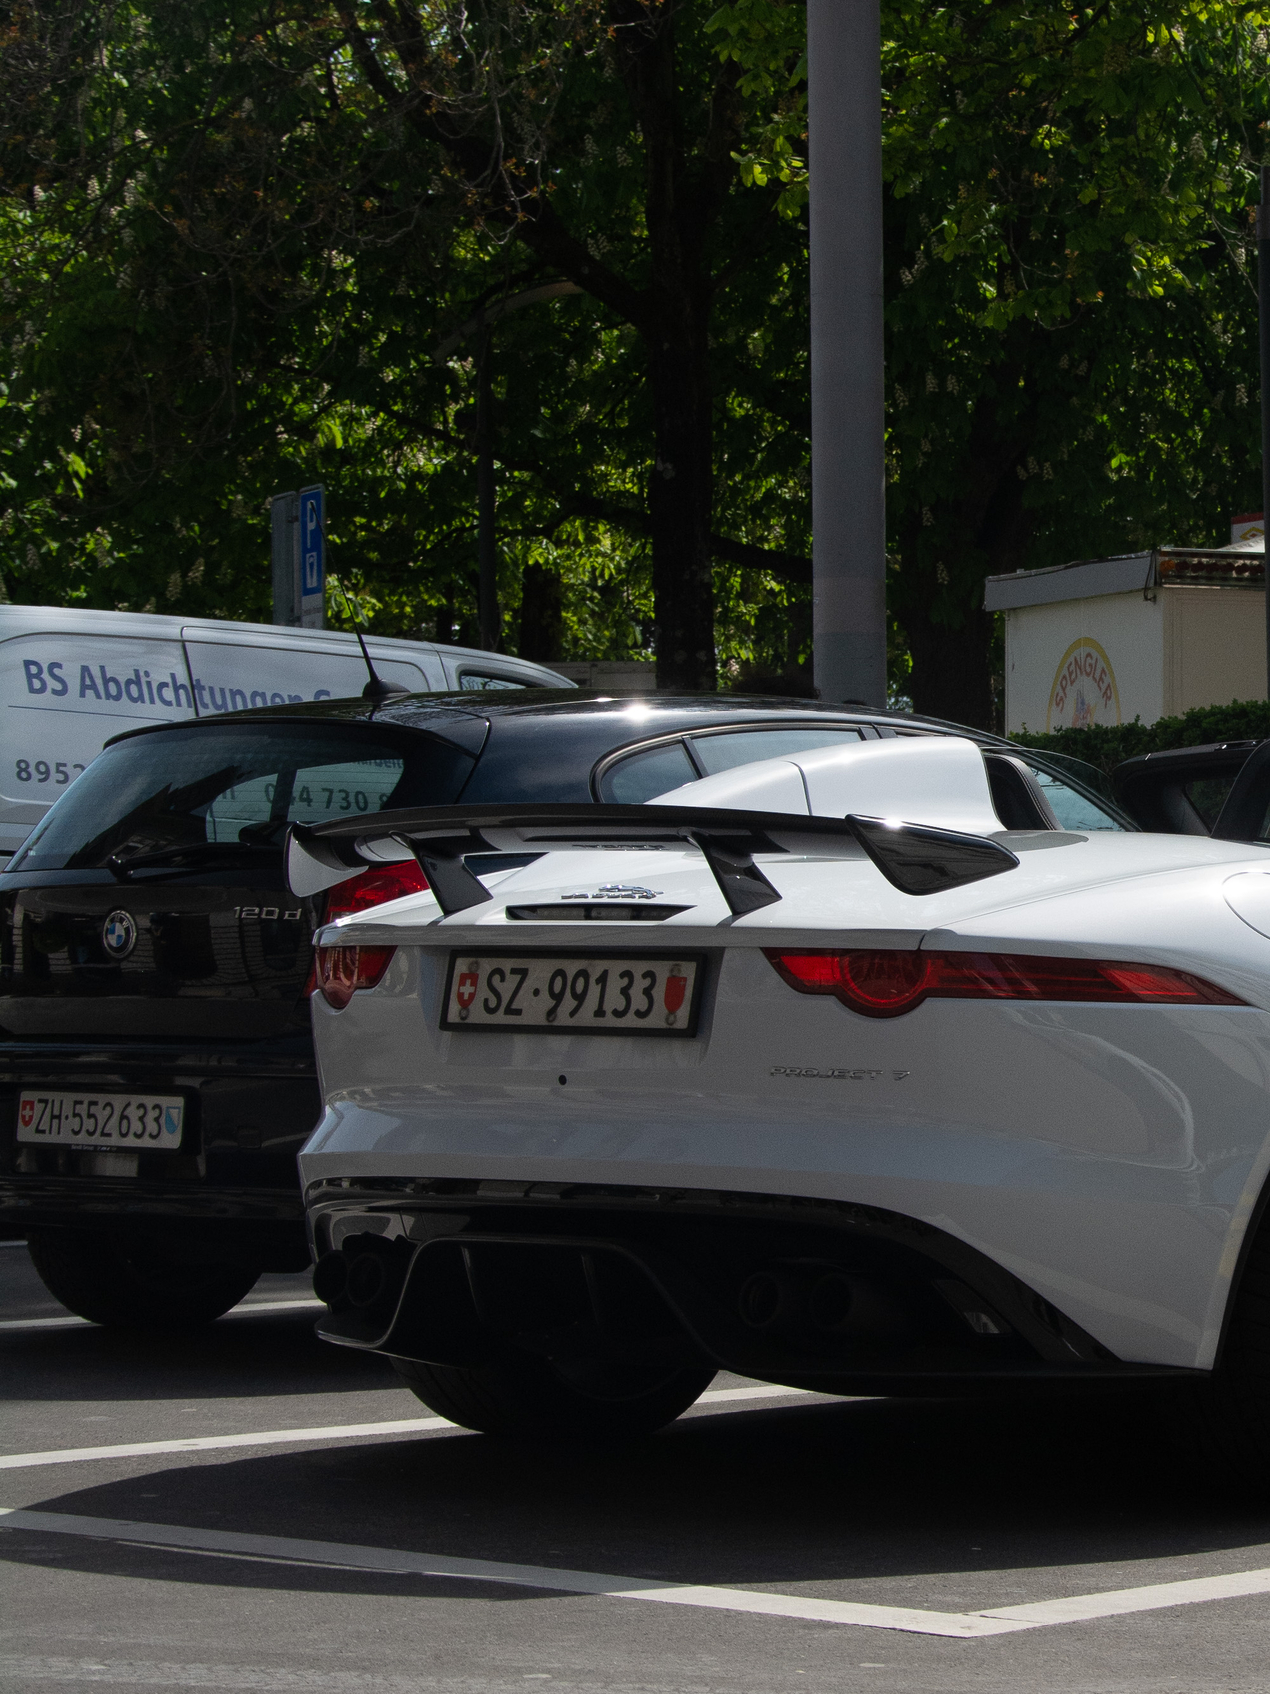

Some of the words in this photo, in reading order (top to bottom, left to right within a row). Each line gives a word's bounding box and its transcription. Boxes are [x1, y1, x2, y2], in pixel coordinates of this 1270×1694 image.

[306, 499, 317, 549] P
[23, 659, 69, 697] BS
[1054, 652, 1113, 714] SPENGLER
[264, 782, 313, 808] 04
[321, 787, 369, 812] 730
[770, 1065, 884, 1080] PROJECT
[892, 1070, 911, 1081] 7
